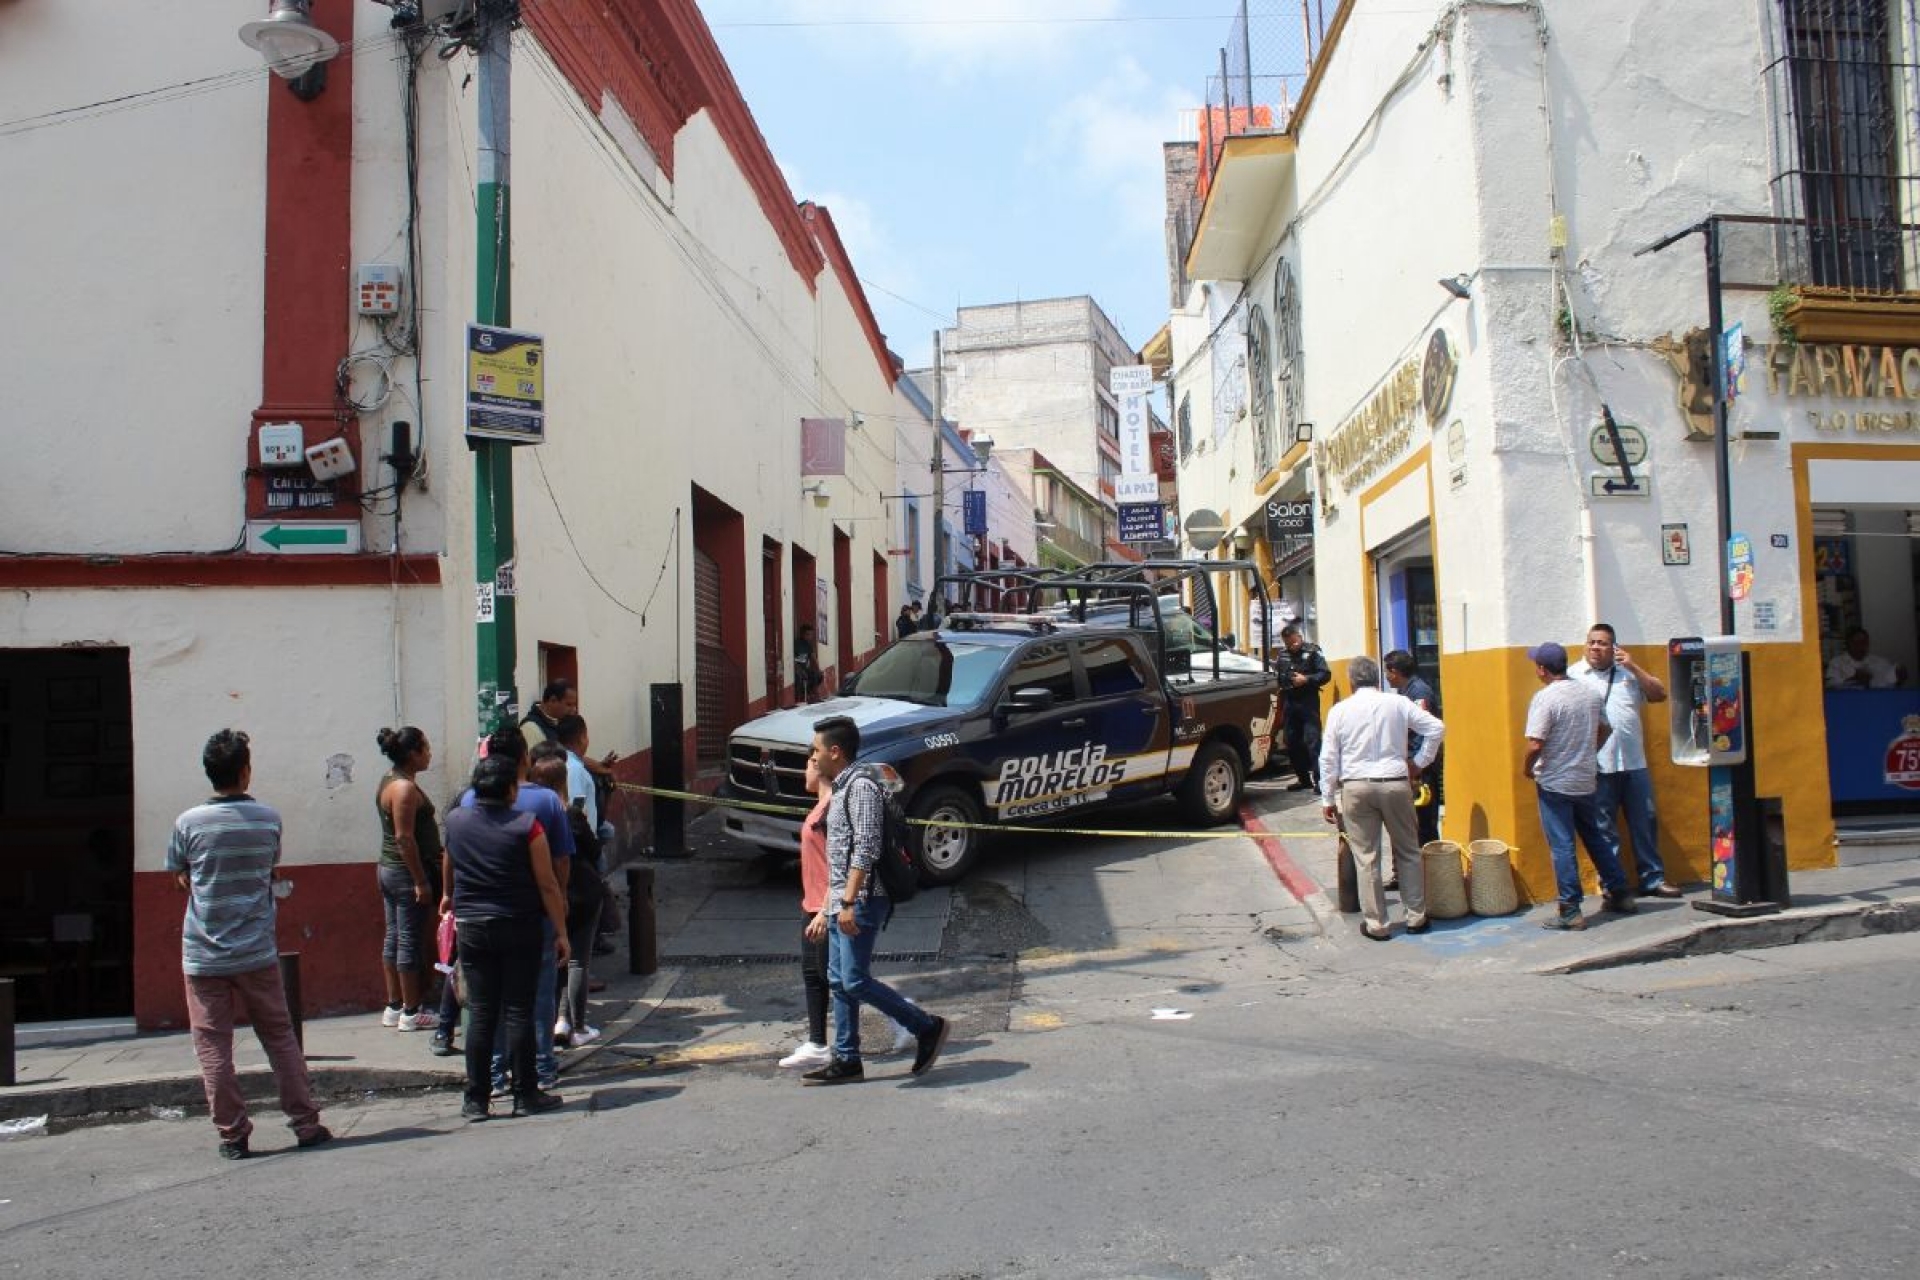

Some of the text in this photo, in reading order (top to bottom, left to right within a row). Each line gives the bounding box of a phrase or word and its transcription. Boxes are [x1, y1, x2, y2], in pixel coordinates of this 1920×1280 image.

[1126, 396, 1140, 473] HOTEL
[1118, 482, 1155, 495] LA PAZ
[923, 732, 960, 749] 00593
[1896, 749, 1920, 771] 75
[995, 759, 1128, 804] MORELOS
[1007, 801, 1049, 817] Cerca
[1052, 795, 1070, 807] de
